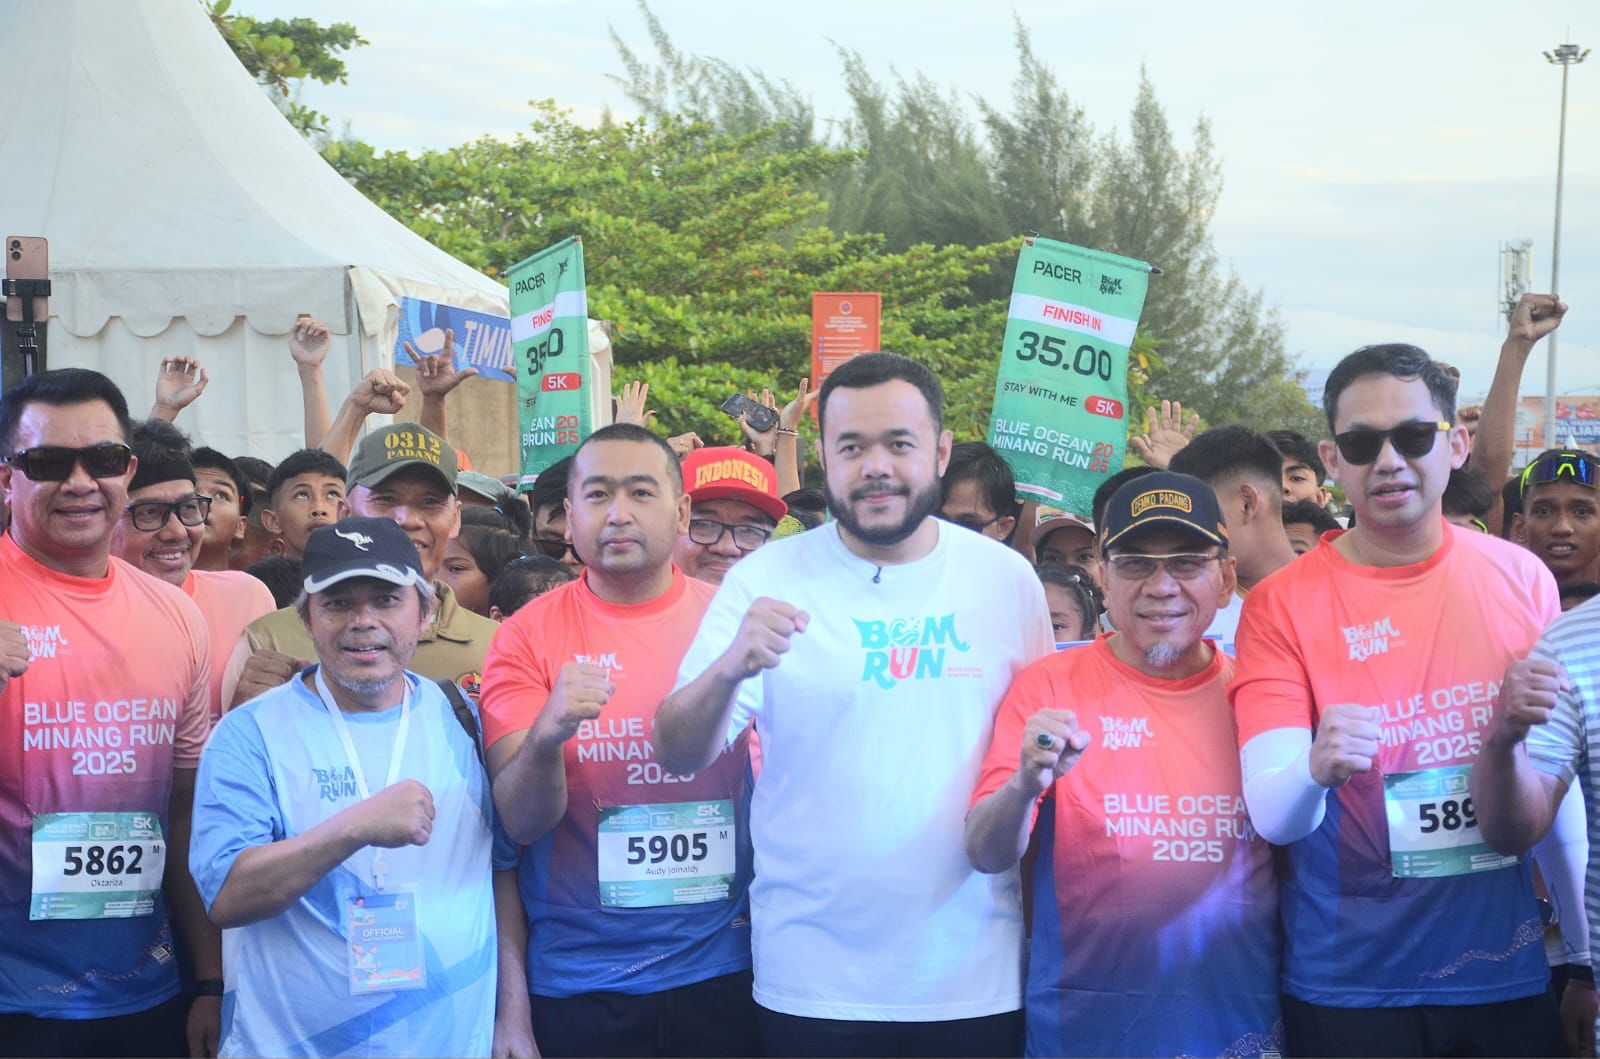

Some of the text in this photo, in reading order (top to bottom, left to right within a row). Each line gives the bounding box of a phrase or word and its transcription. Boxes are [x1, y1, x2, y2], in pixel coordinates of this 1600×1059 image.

[515, 272, 546, 296] PACER
[1033, 260, 1082, 285] PACER
[1043, 303, 1102, 331] FINISH IN
[1016, 331, 1112, 381] 35.00
[548, 374, 569, 389] 5K
[1003, 382, 1078, 406] STAY WITH ME
[1095, 400, 1116, 416] 5K
[556, 415, 579, 429] 20
[384, 431, 441, 456] 0312
[556, 430, 580, 445] 25
[995, 418, 1114, 458] BLUE OCEAN 20
[387, 449, 440, 465] PADANG
[992, 434, 1110, 474] MINANG RUN 25
[695, 459, 769, 494] INDONESIA
[1159, 493, 1189, 509] PADANG
[1349, 637, 1388, 662] RUN
[862, 647, 946, 690] RUN
[25, 698, 177, 725] BLUE OCEAN
[1382, 679, 1503, 723] LUE OCEA
[23, 723, 175, 752] MINANG RUN
[577, 717, 644, 741] BLUE
[1102, 732, 1142, 751] RUN
[1414, 732, 1482, 765] 2025
[71, 751, 137, 777] 2025
[320, 781, 357, 802] RUN
[697, 803, 720, 817] 5K
[1103, 793, 1247, 815] BLUE OCEA
[132, 815, 154, 830] 5K
[1105, 817, 1208, 838] MINANG
[627, 830, 728, 865] 5905 M
[1152, 840, 1224, 863] 2025
[63, 844, 160, 877] 5862 M
[646, 867, 666, 877] Audy
[90, 879, 124, 888] Oktariza
[362, 927, 406, 938] OFFICIAL
